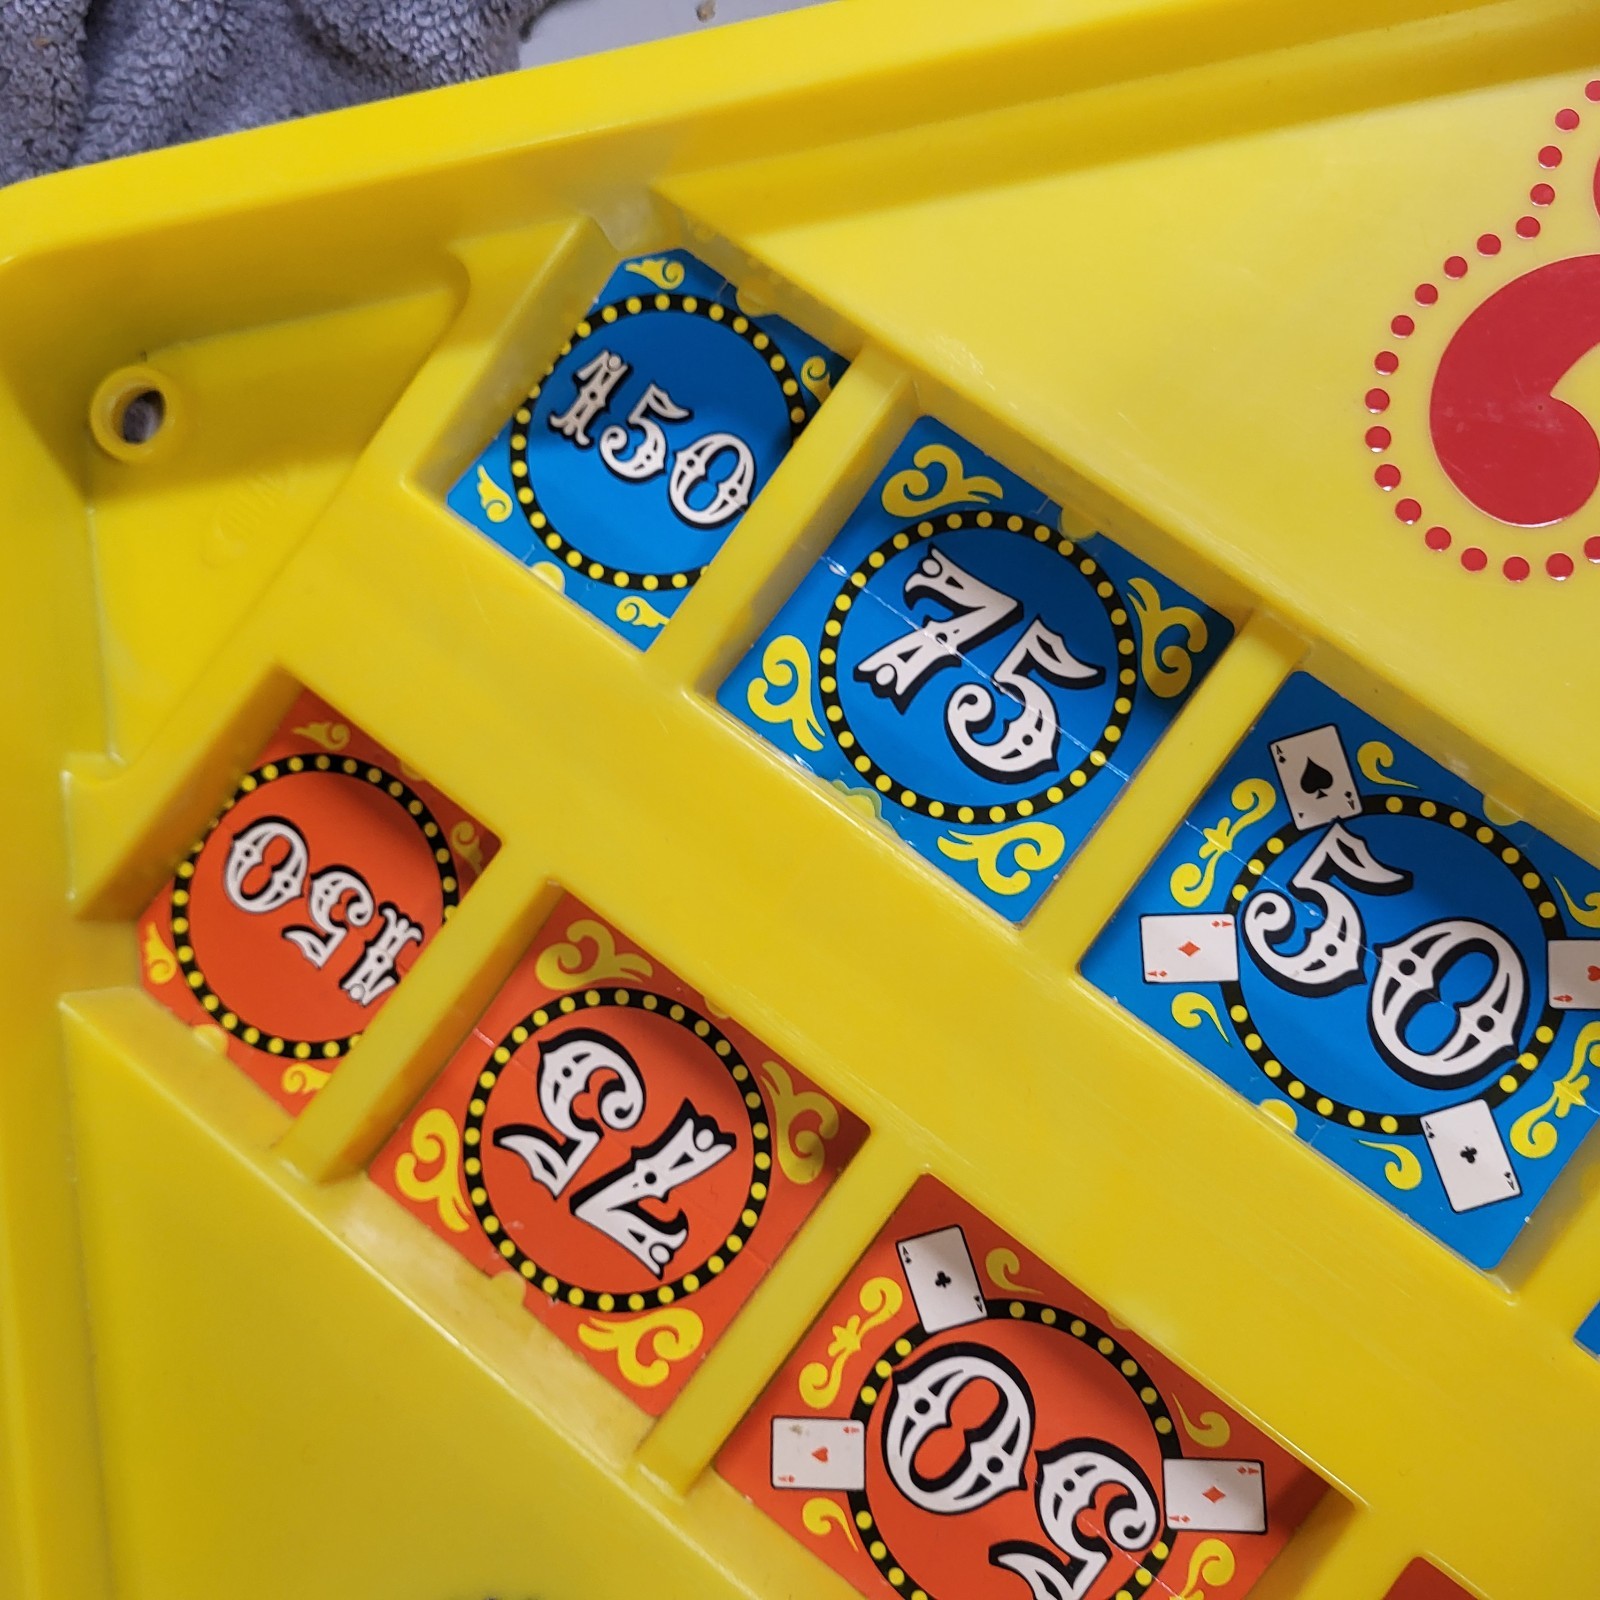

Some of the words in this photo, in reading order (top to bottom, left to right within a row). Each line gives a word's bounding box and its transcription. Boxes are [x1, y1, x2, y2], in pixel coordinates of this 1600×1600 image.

[549, 349, 756, 528] 150
[853, 543, 1106, 785] 75
[1275, 744, 1283, 756] A
[223, 815, 424, 1007] 150
[1240, 815, 1530, 1090] 50
[492, 1026, 736, 1278] 75
[880, 1341, 1162, 1600] 50
